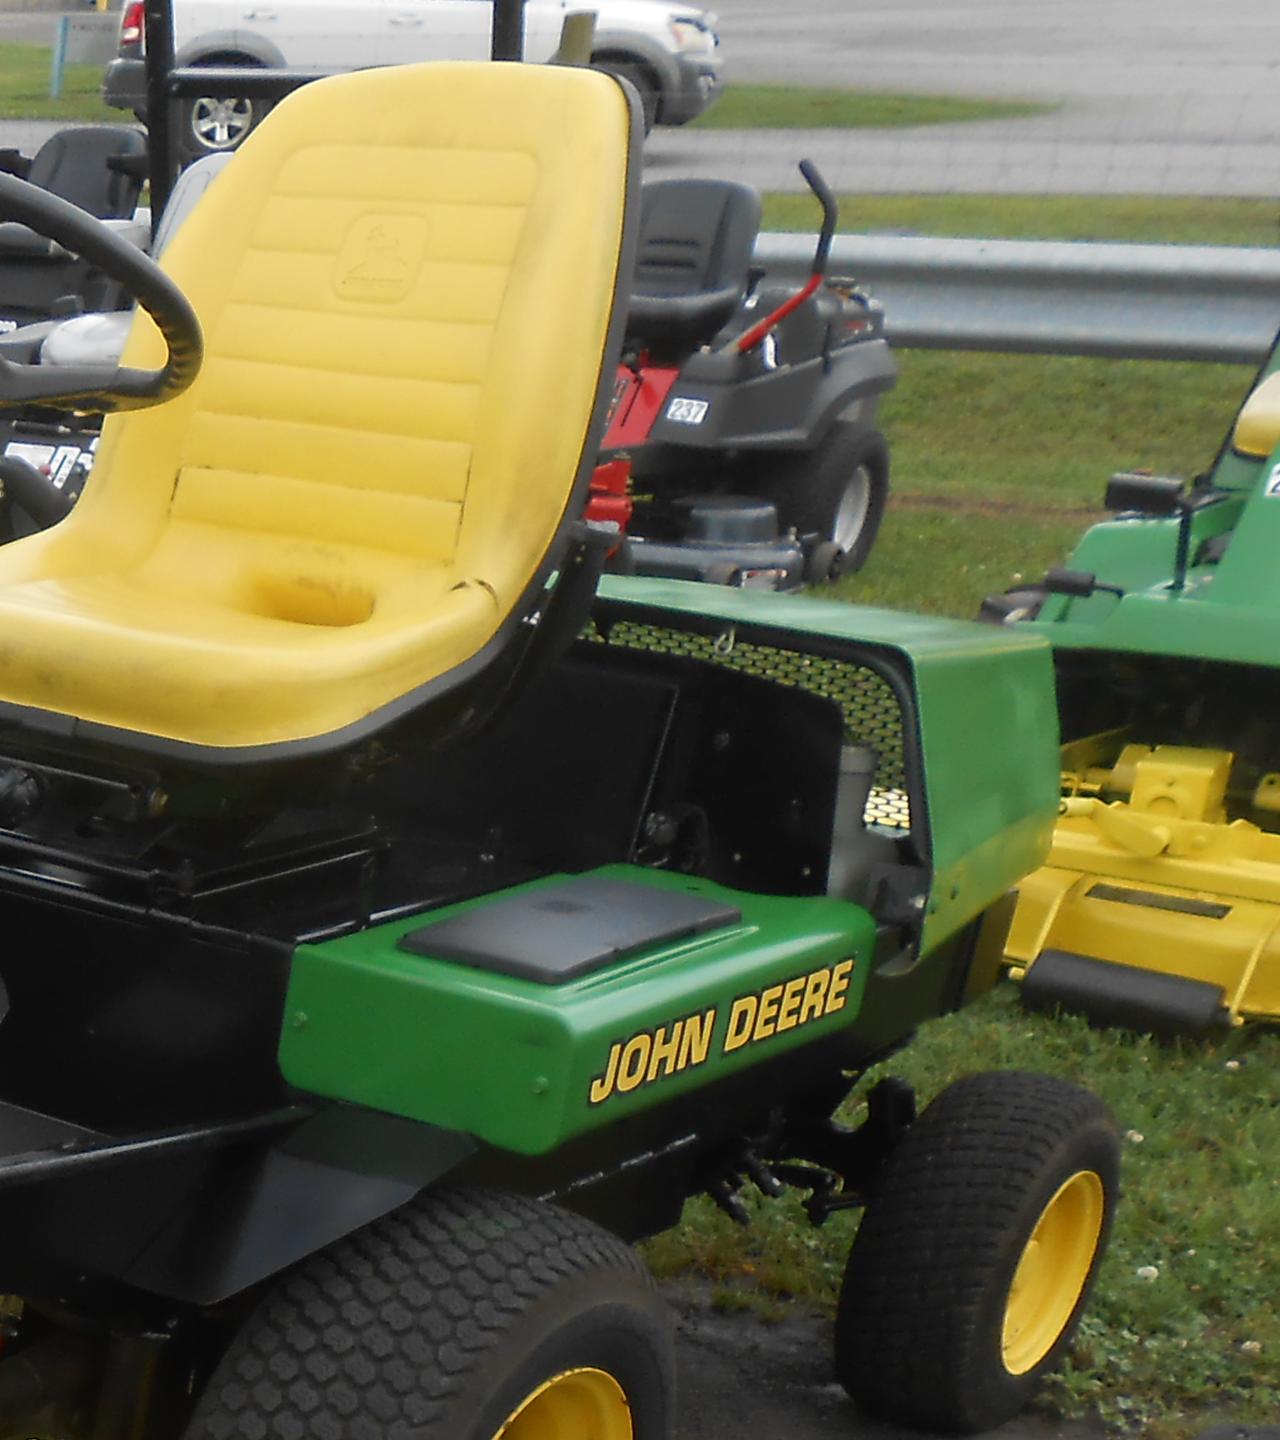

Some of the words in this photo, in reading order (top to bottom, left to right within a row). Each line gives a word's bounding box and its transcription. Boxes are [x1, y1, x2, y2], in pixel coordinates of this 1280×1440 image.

[670, 400, 706, 420] 237
[589, 1008, 716, 1104] JOHN
[723, 958, 854, 1052] DEERE
